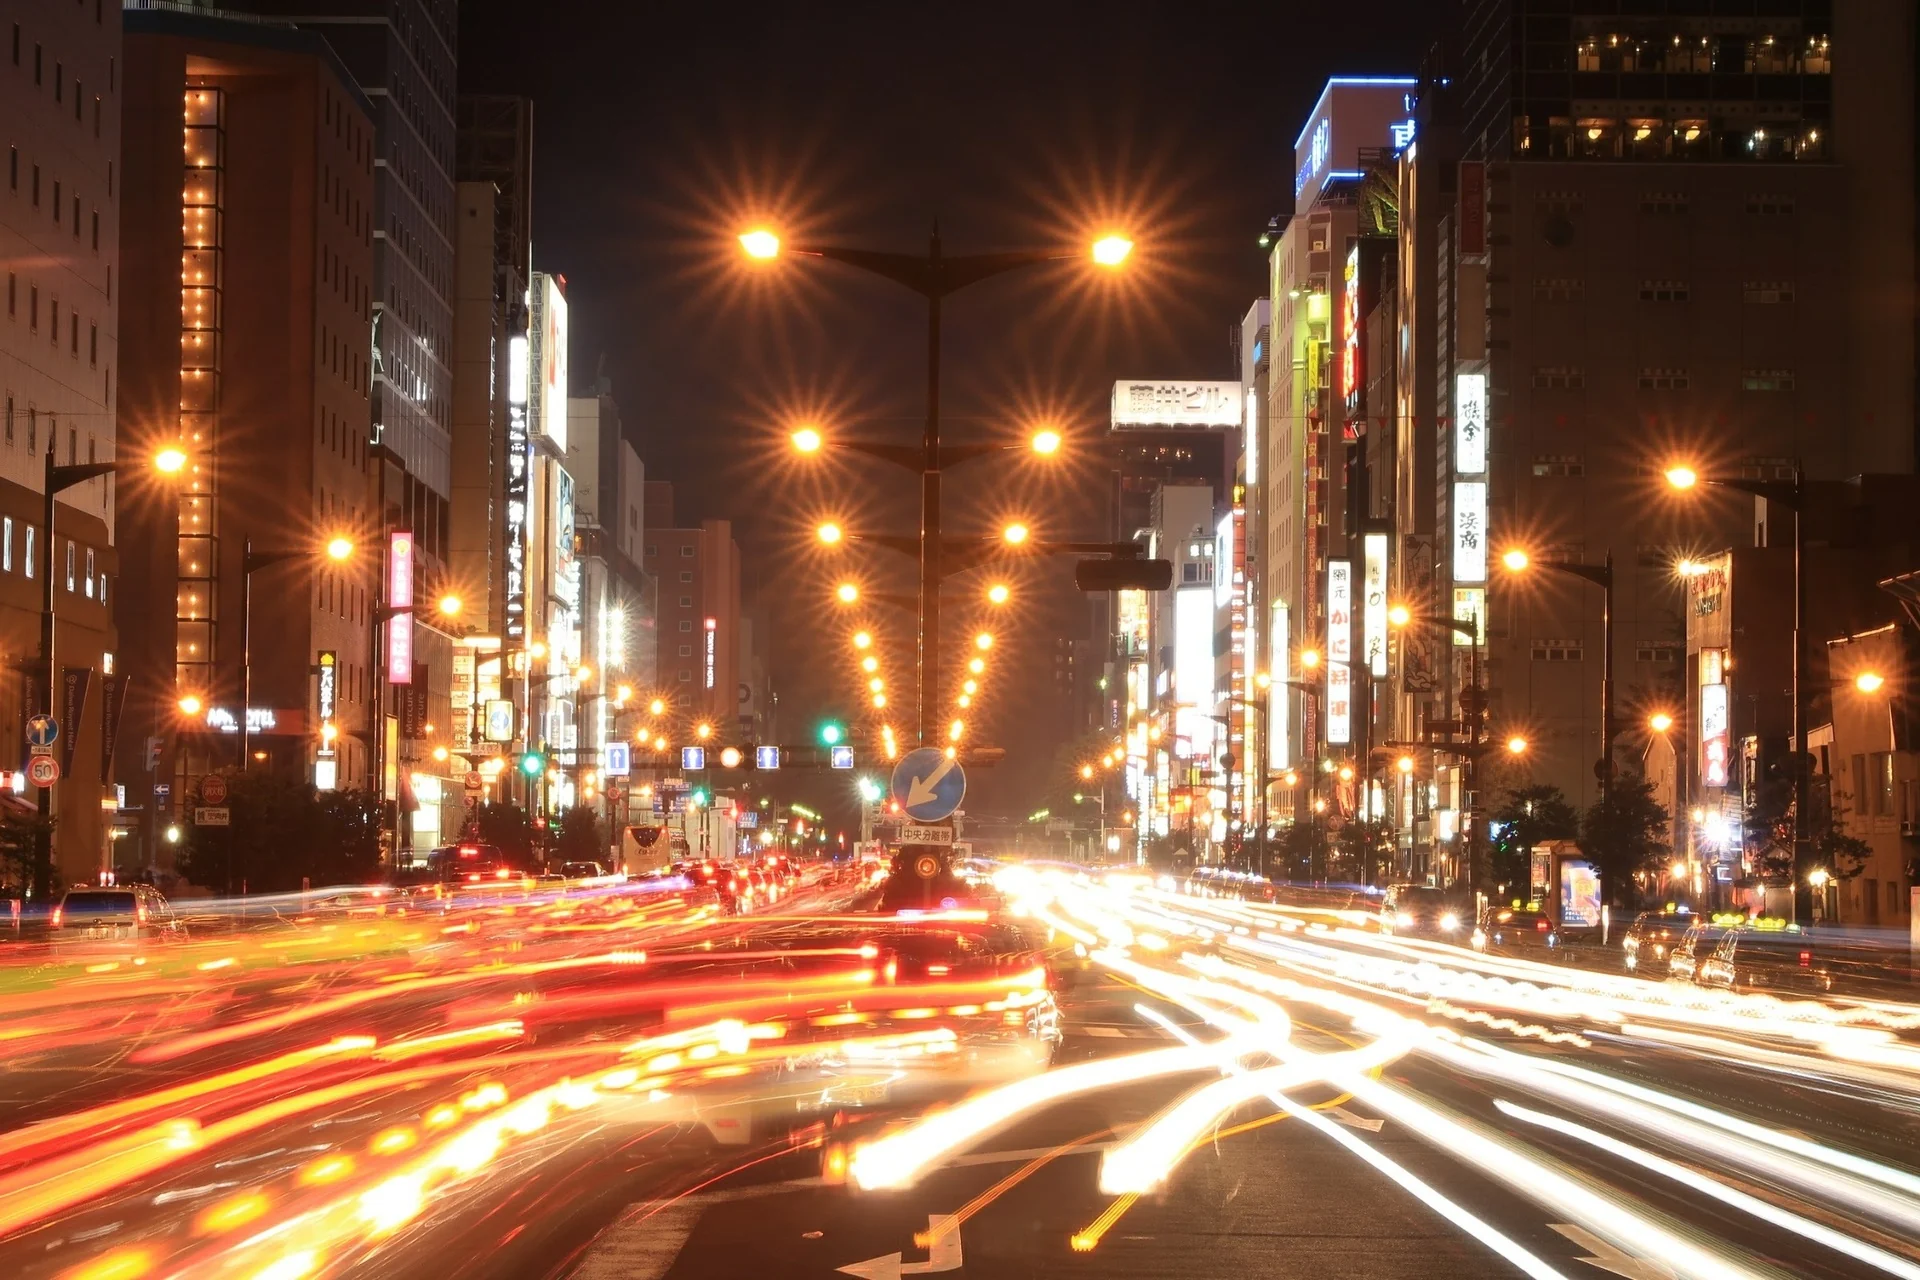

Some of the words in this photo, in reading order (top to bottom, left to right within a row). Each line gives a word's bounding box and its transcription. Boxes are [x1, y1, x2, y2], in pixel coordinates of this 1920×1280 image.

[320, 666, 334, 718] アパホテル
[245, 707, 276, 727] OTEL
[406, 689, 414, 733] Mercure
[416, 693, 425, 736] Mercure
[34, 764, 52, 779] 50
[904, 829, 950, 842] 中央分離帯
